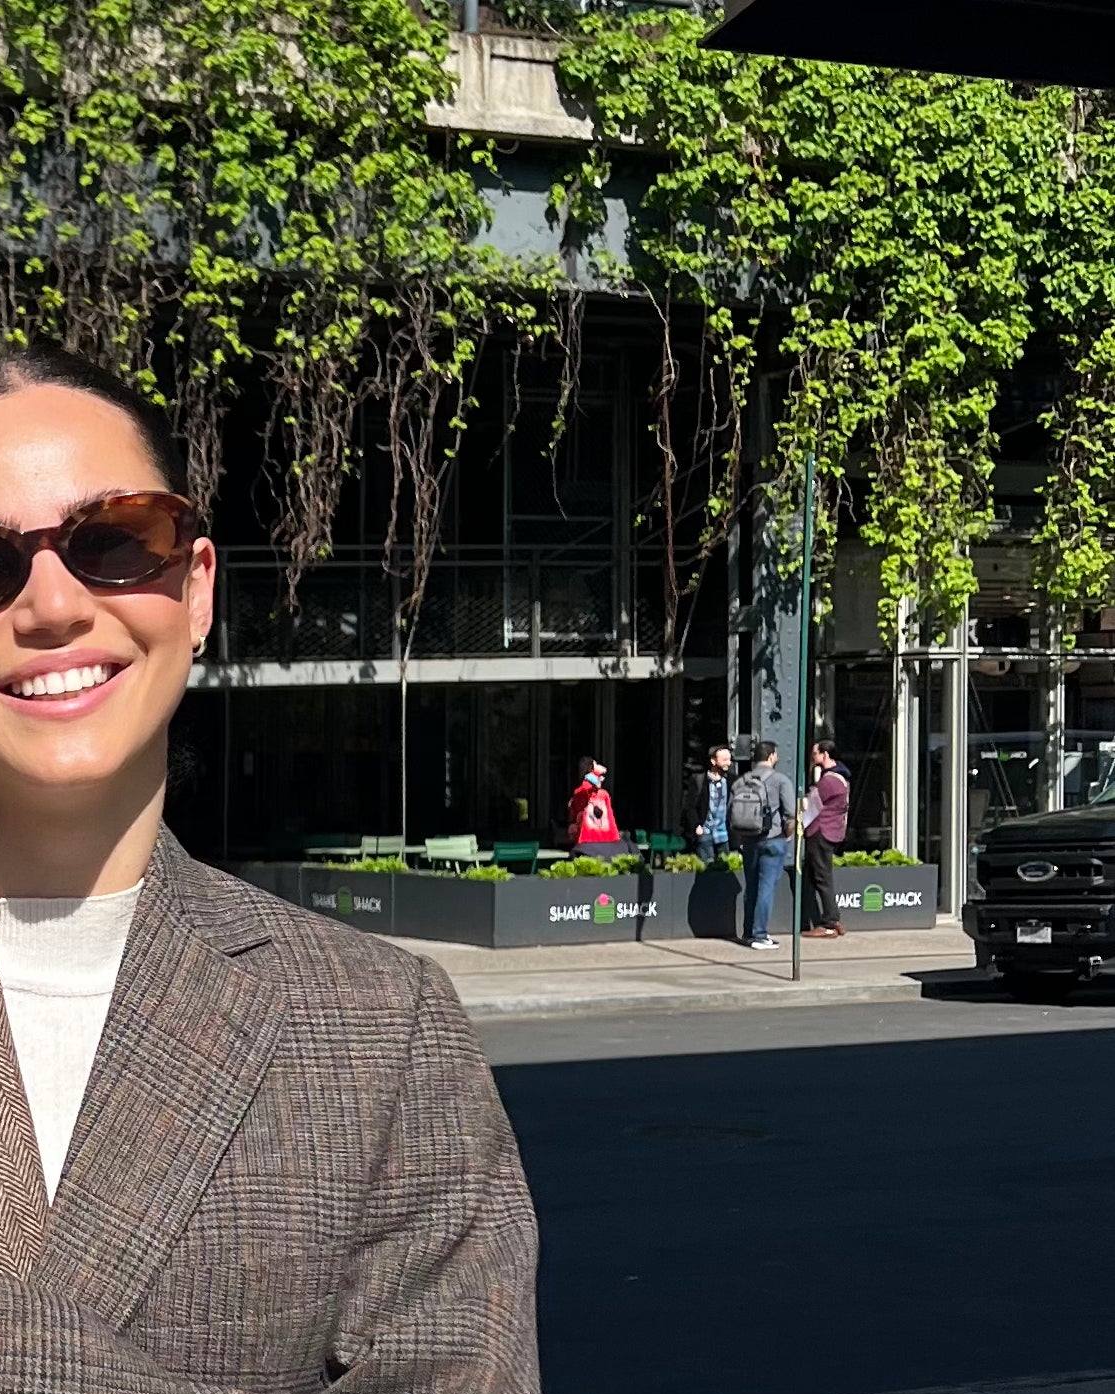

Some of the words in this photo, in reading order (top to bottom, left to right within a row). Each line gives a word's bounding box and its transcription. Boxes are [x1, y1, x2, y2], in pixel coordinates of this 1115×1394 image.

[835, 892, 861, 908] AKE
[884, 891, 922, 907] SHACK
[549, 904, 591, 922] SHAKE
[616, 901, 658, 919] SHACK
